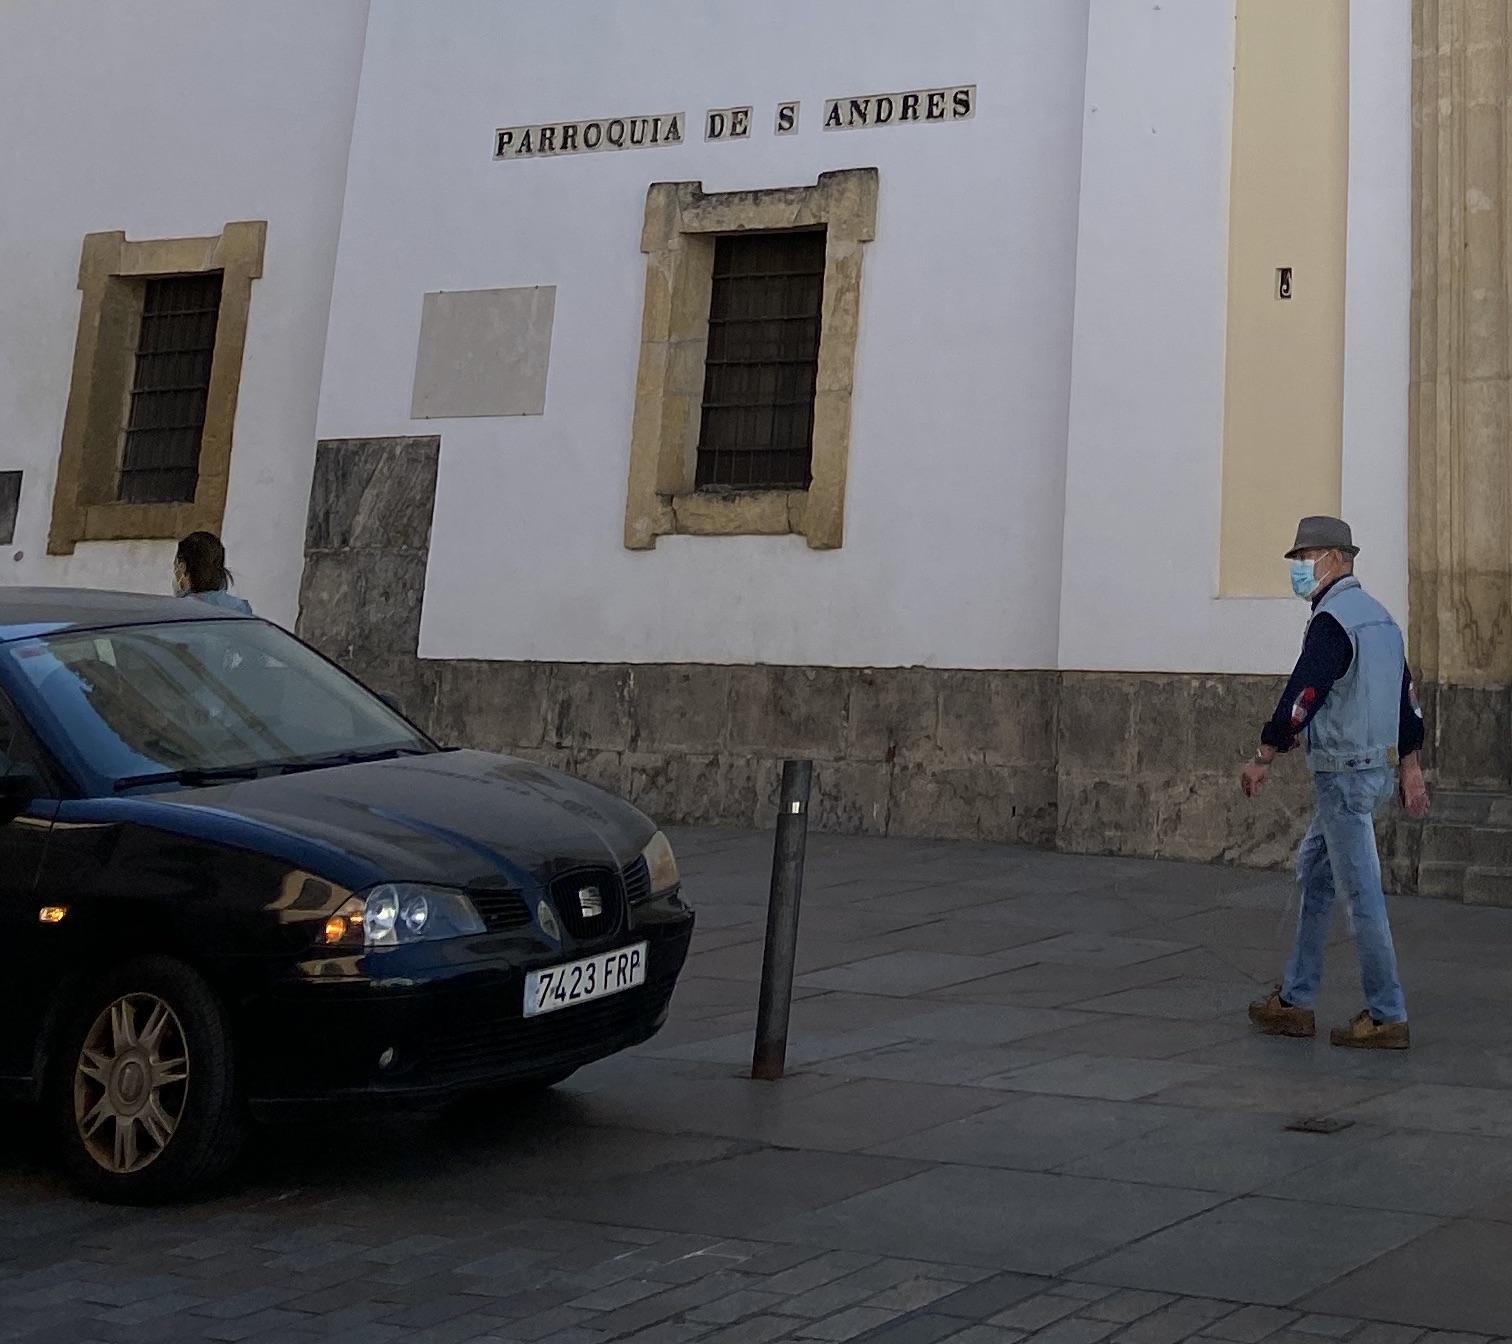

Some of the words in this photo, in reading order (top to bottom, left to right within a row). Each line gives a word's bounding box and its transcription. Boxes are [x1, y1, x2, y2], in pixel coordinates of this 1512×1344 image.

[496, 116, 682, 156] PARROQUIA
[708, 110, 749, 139] DE
[778, 105, 796, 132] S
[825, 89, 972, 127] ANDRES
[538, 962, 596, 1008] 7423
[604, 949, 640, 990] FRP
